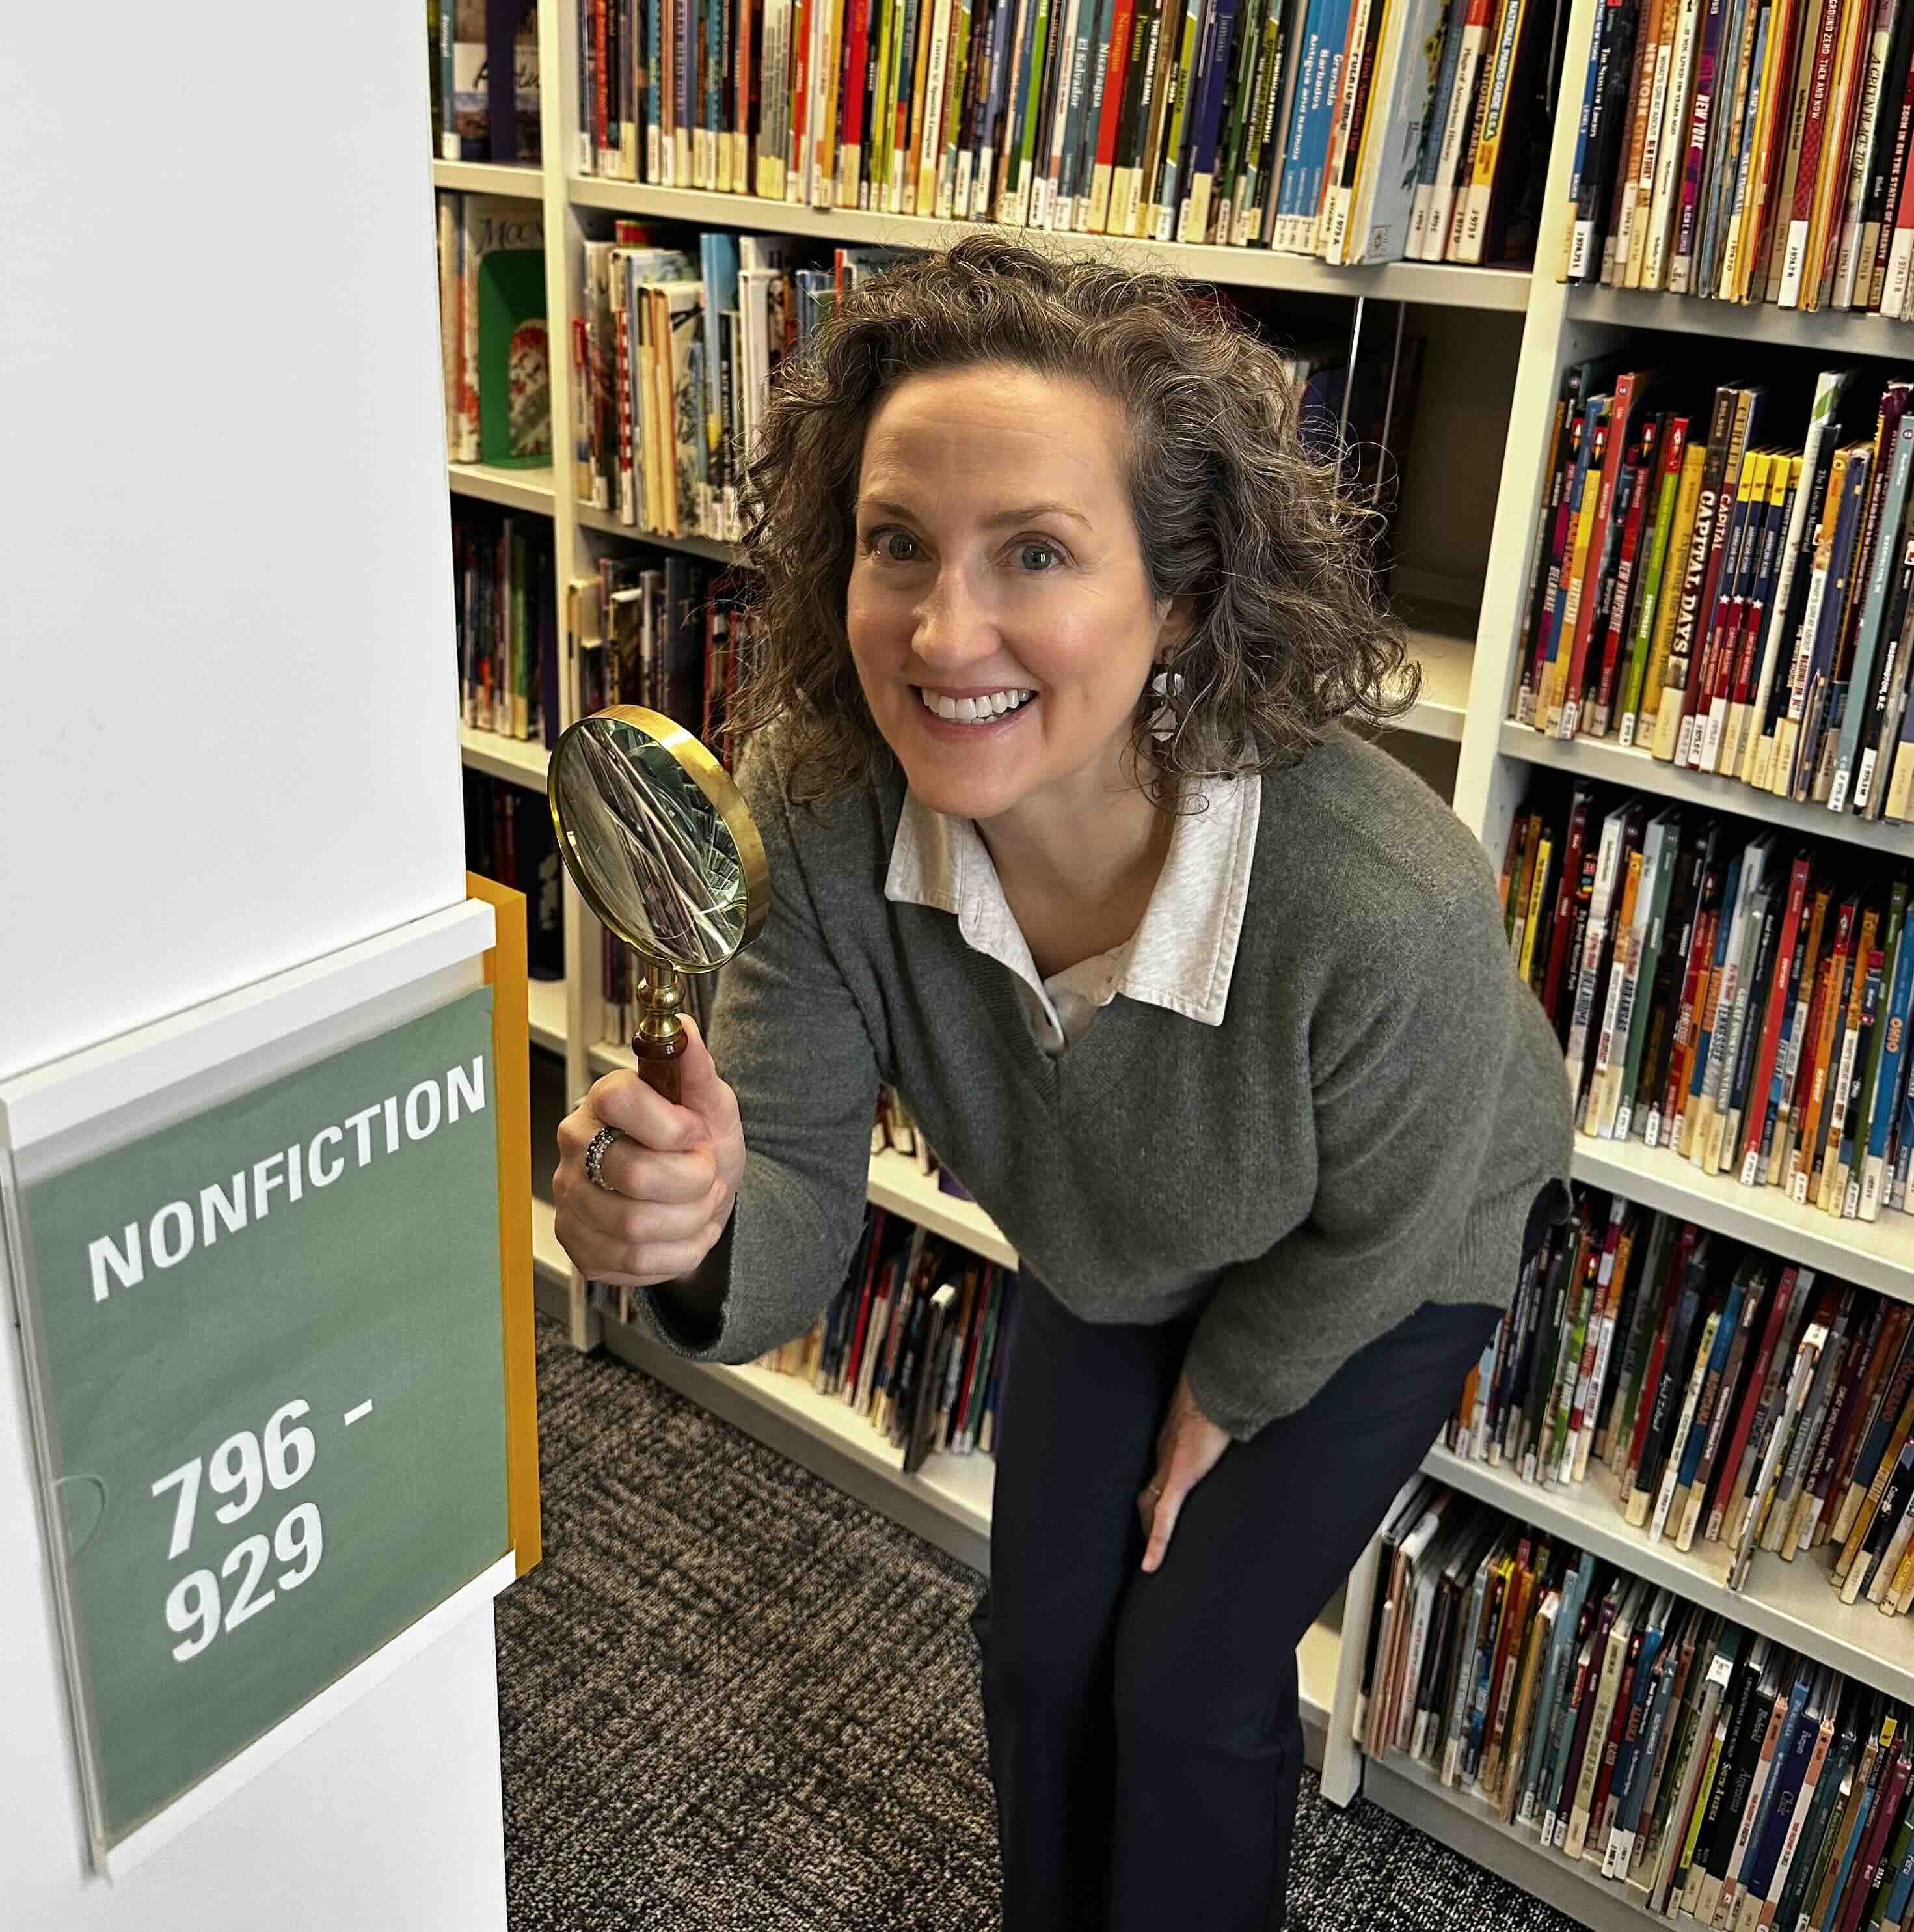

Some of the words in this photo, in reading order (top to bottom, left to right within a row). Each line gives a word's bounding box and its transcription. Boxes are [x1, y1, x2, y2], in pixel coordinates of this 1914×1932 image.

[1502, 0, 1519, 47] NATIONAL
[1145, 38, 1157, 76] PANAMA
[1300, 33, 1319, 85] Antigua
[1494, 48, 1511, 82] PARKS
[1641, 41, 1658, 74] NEW
[1816, 57, 1829, 81] THEN
[1068, 51, 1088, 109] Salvador
[1090, 40, 1110, 109] Nicaragua
[1140, 77, 1152, 106] CANAL
[1310, 48, 1329, 110] Barbados
[1325, 53, 1343, 107] Grenada
[1813, 81, 1826, 100] AND
[1862, 66, 1880, 109] GREEN
[1490, 81, 1505, 111] GUIDE
[1636, 76, 1652, 116] YORK
[1693, 93, 1710, 121] NEW
[1810, 99, 1822, 120] NOW
[1649, 111, 1660, 136] ABOUT
[1898, 103, 1911, 129] ZOOM
[1689, 121, 1707, 151] YORK
[1894, 142, 1905, 156] ON
[1896, 130, 1906, 141] IN
[1891, 156, 1903, 176] THE
[1885, 176, 1900, 210] STATUE
[1334, 219, 1343, 236] 973
[1454, 217, 1463, 234] 973
[1468, 216, 1478, 232] 973
[1883, 210, 1893, 223] OF
[1877, 223, 1891, 260] LIBERTY
[1710, 493, 1731, 552] CAPITAL
[1682, 489, 1716, 591] CAPITAL
[1615, 559, 1633, 583] NEW
[1607, 581, 1629, 634] HAMPSHIRE
[1671, 593, 1697, 654] DAYS
[1884, 1016, 1904, 1054] OHIO
[88, 1055, 487, 1302] NONFICTION
[151, 1398, 317, 1560] 796
[165, 1502, 323, 1663] 929
[1716, 1761, 1732, 1790] SOUTH
[1708, 1788, 1725, 1823] AMERICA
